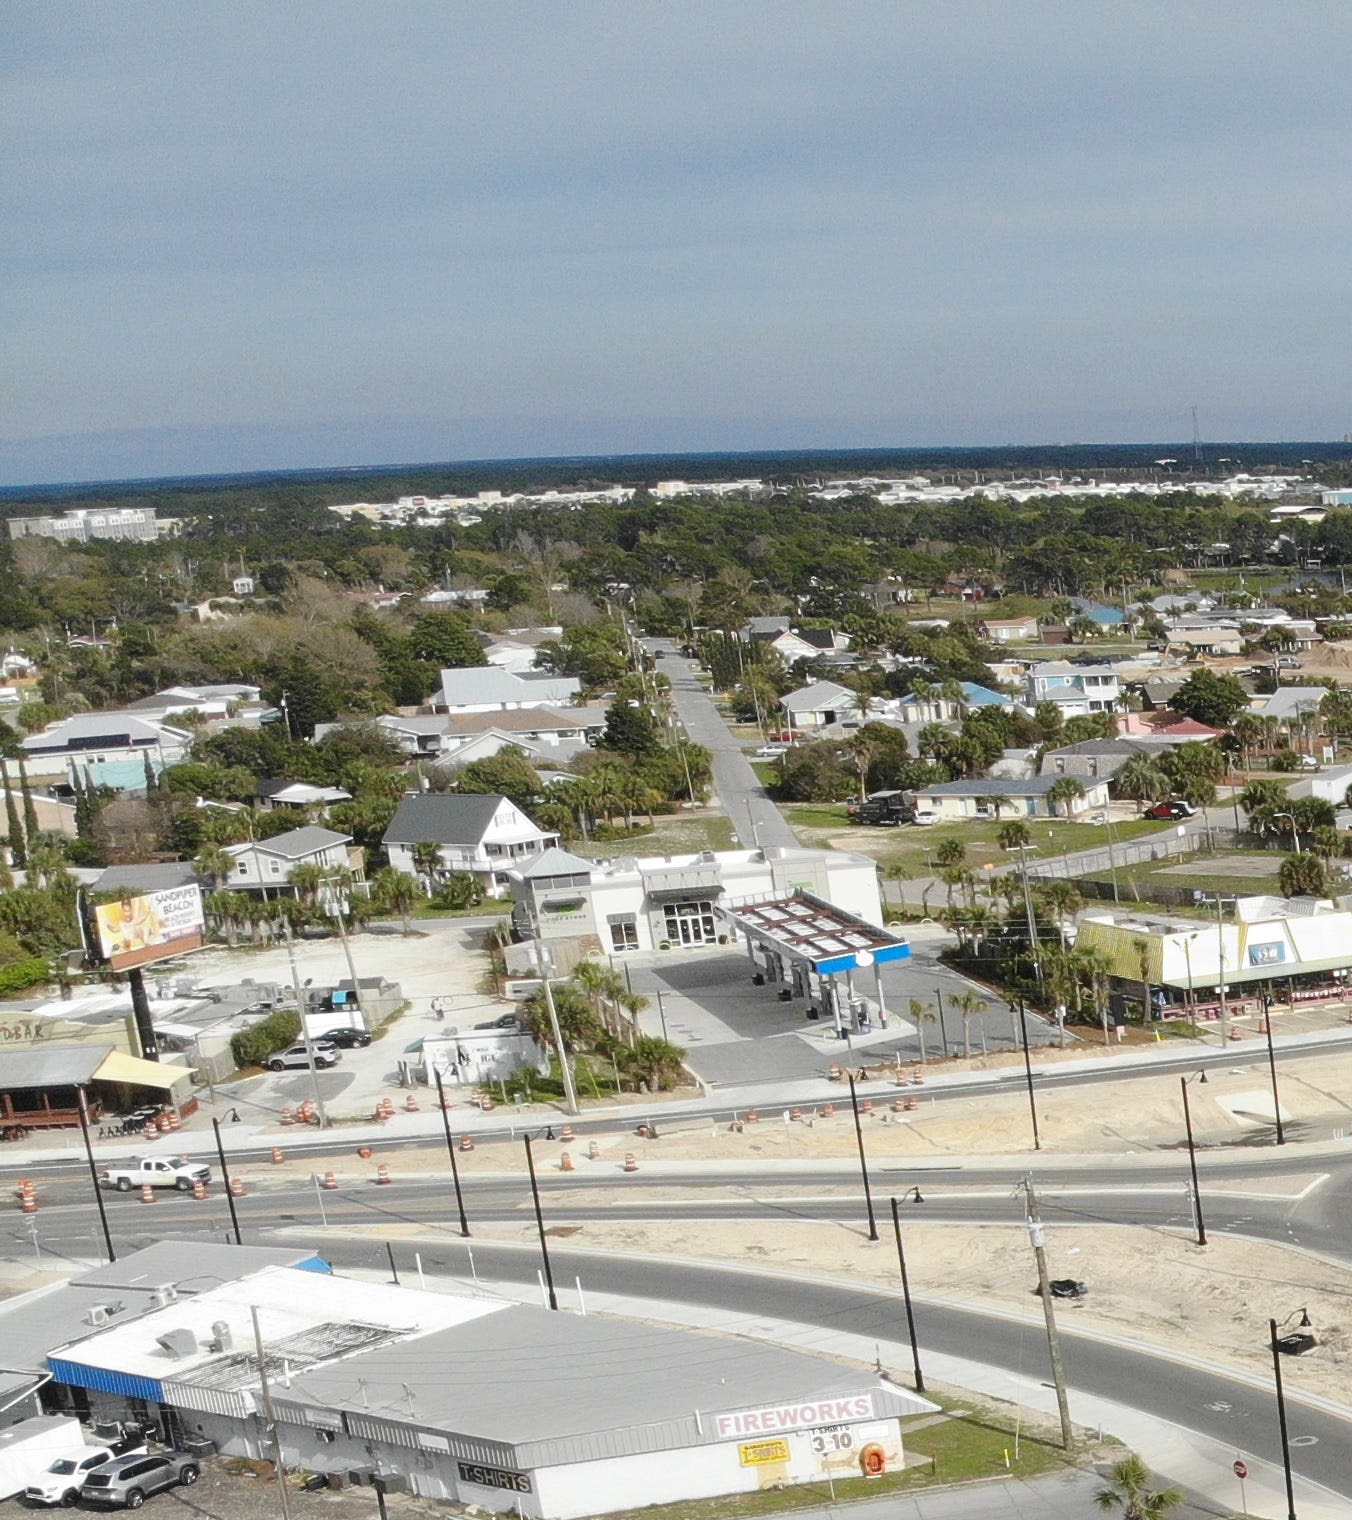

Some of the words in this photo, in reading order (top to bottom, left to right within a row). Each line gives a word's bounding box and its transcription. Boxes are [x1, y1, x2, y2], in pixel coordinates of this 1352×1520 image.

[155, 887, 199, 905] SANDPIPER
[163, 899, 194, 915] BEACON
[717, 1396, 872, 1436] FIREWORKS
[812, 1436, 826, 1453] 3
[832, 1432, 853, 1450] 10
[460, 1465, 530, 1492] T-SHIRTS
